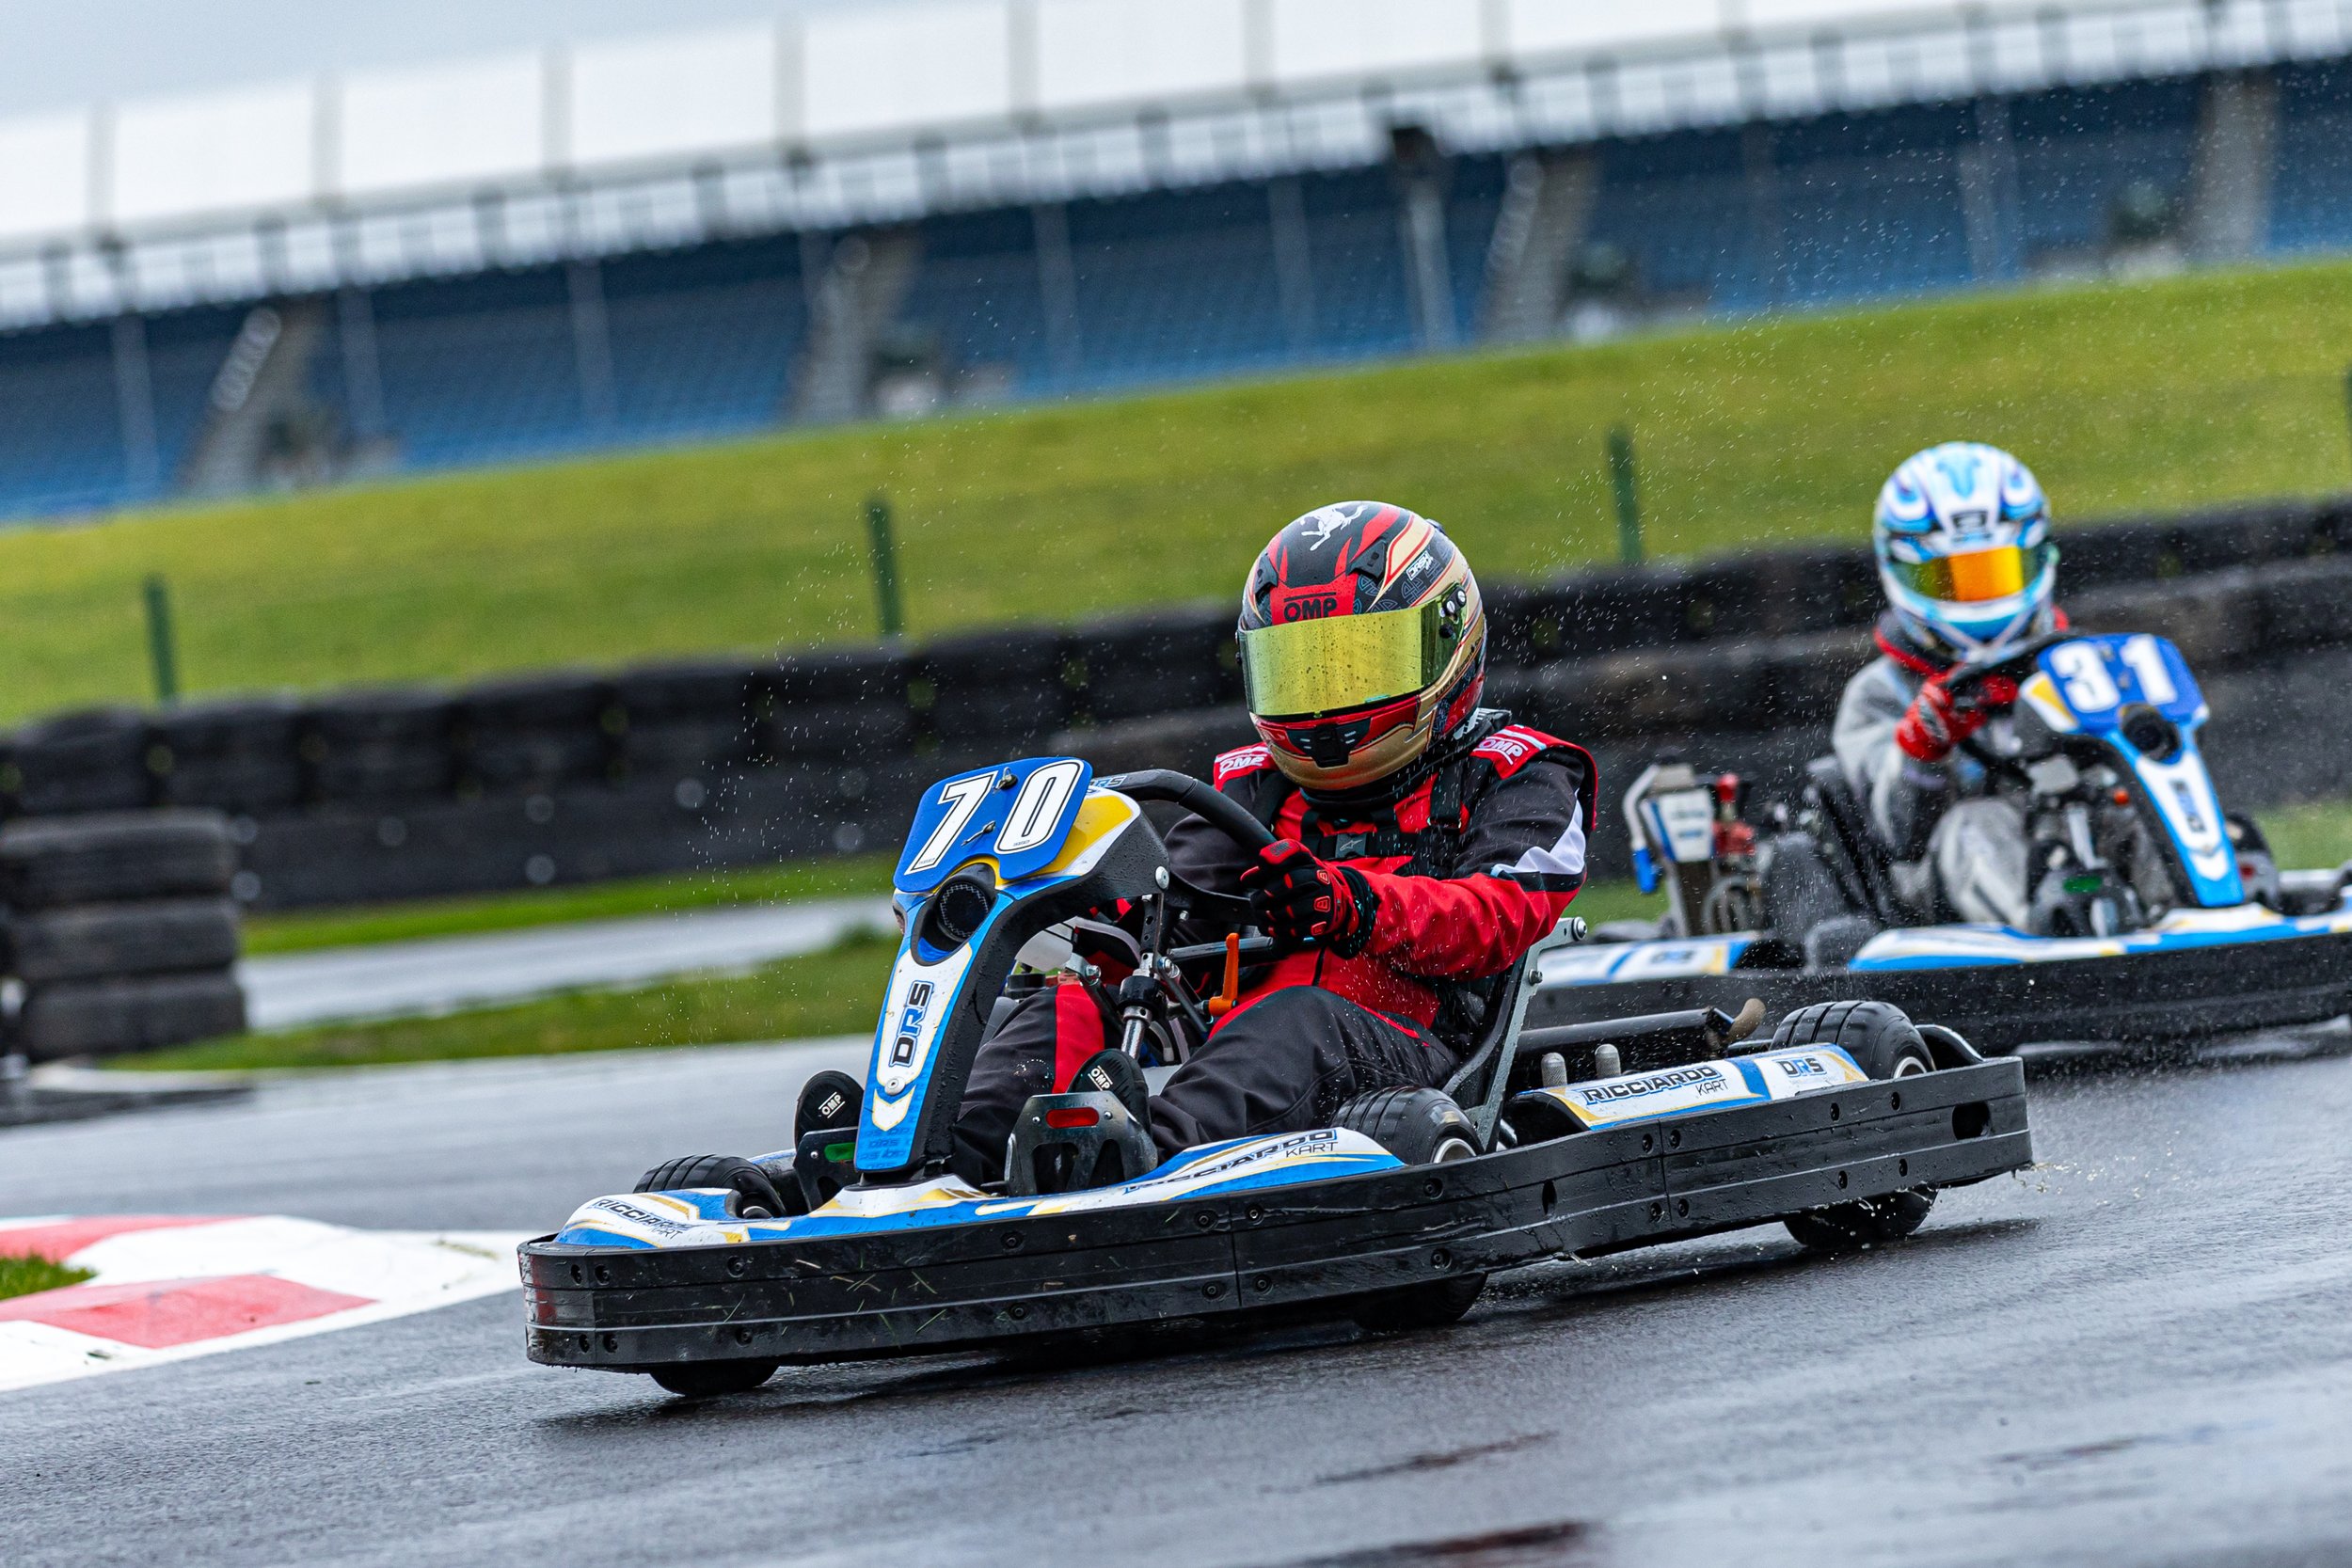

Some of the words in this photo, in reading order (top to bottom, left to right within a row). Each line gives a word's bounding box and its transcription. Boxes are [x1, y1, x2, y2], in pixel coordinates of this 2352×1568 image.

[1284, 597, 1337, 622] OMP
[2049, 633, 2180, 713] 31
[1478, 738, 1523, 757] OMP
[1090, 775, 1127, 787] RS
[904, 758, 1085, 876] 70
[889, 981, 933, 1067] DRS
[1779, 1057, 1826, 1077] DRS
[1090, 1068, 1110, 1089] OMP
[1579, 1065, 1721, 1104] RICCIARDO
[1695, 1078, 1728, 1096] KART
[821, 1094, 842, 1116] OMP
[1285, 1142, 1339, 1158] KART
